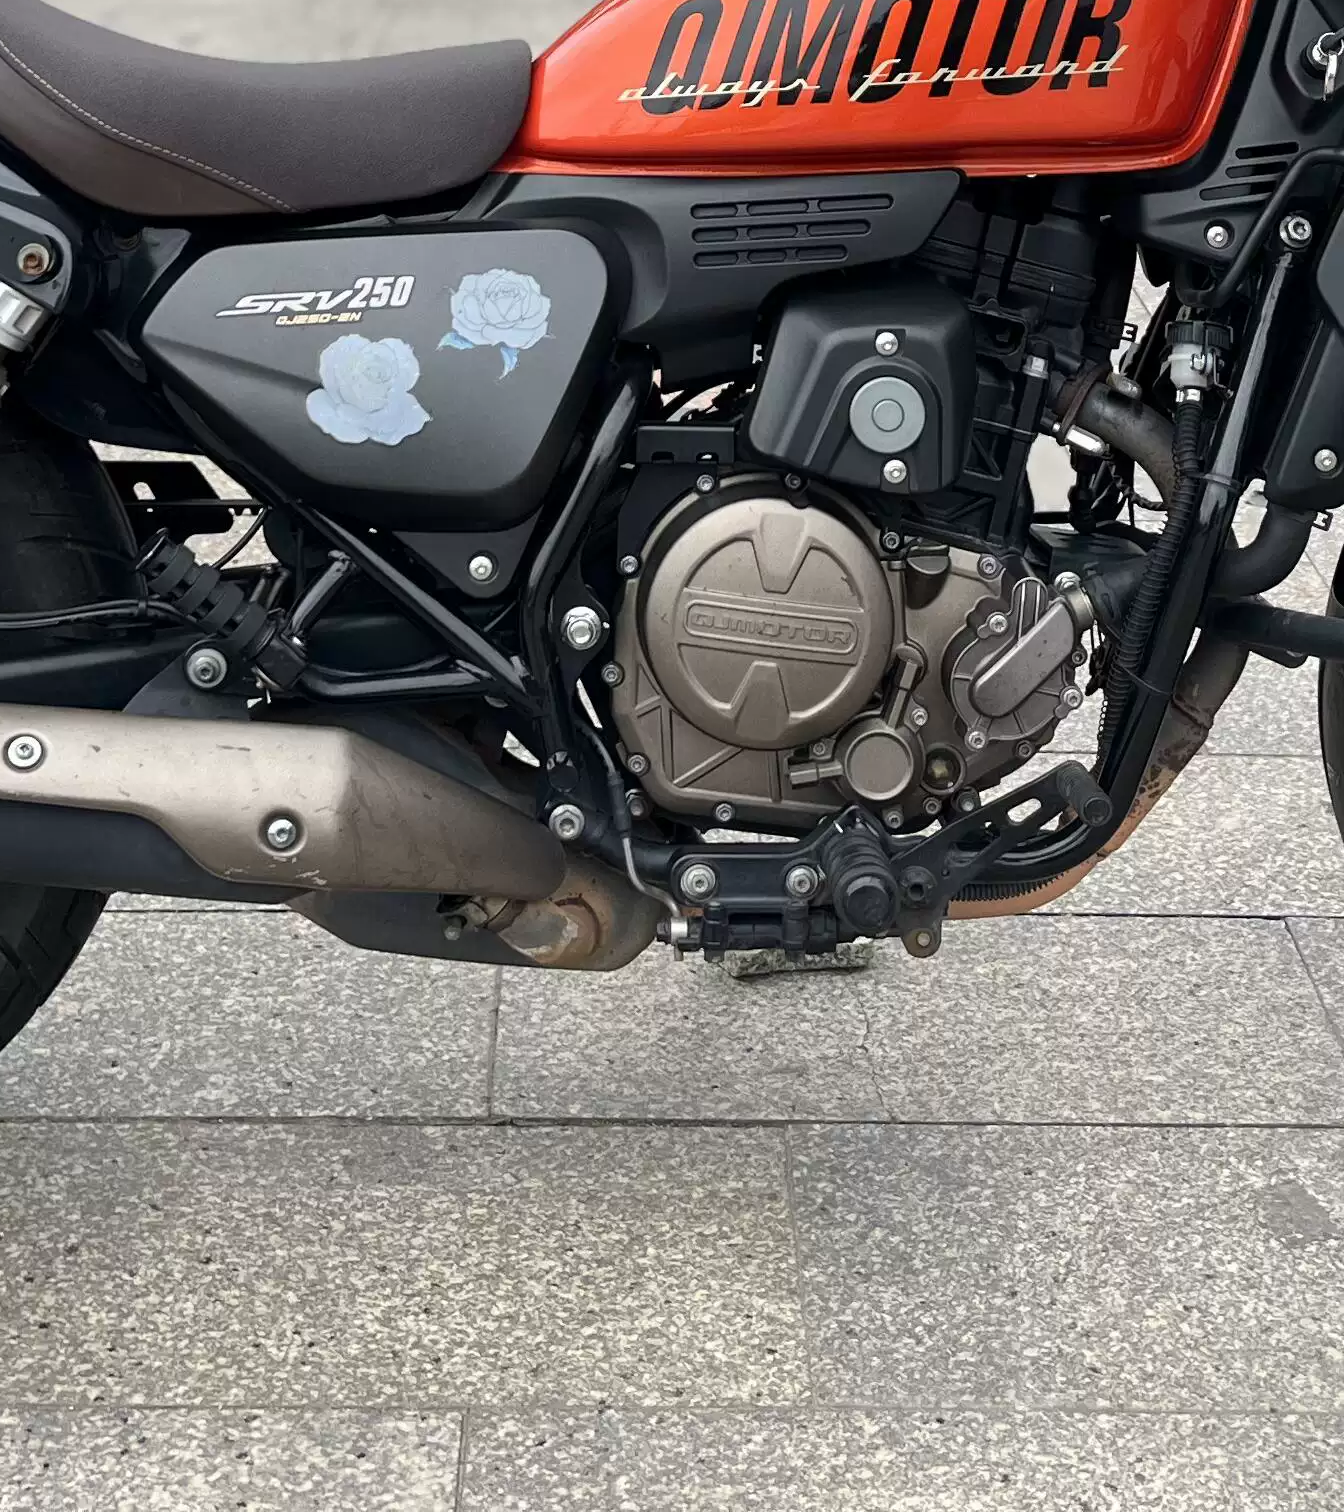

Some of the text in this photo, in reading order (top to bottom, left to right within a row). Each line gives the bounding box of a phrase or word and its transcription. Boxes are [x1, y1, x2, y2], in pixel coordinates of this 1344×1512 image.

[616, 43, 1128, 109] always forward
[215, 275, 416, 317] SRV250
[690, 612, 853, 645] QJMOTOR
